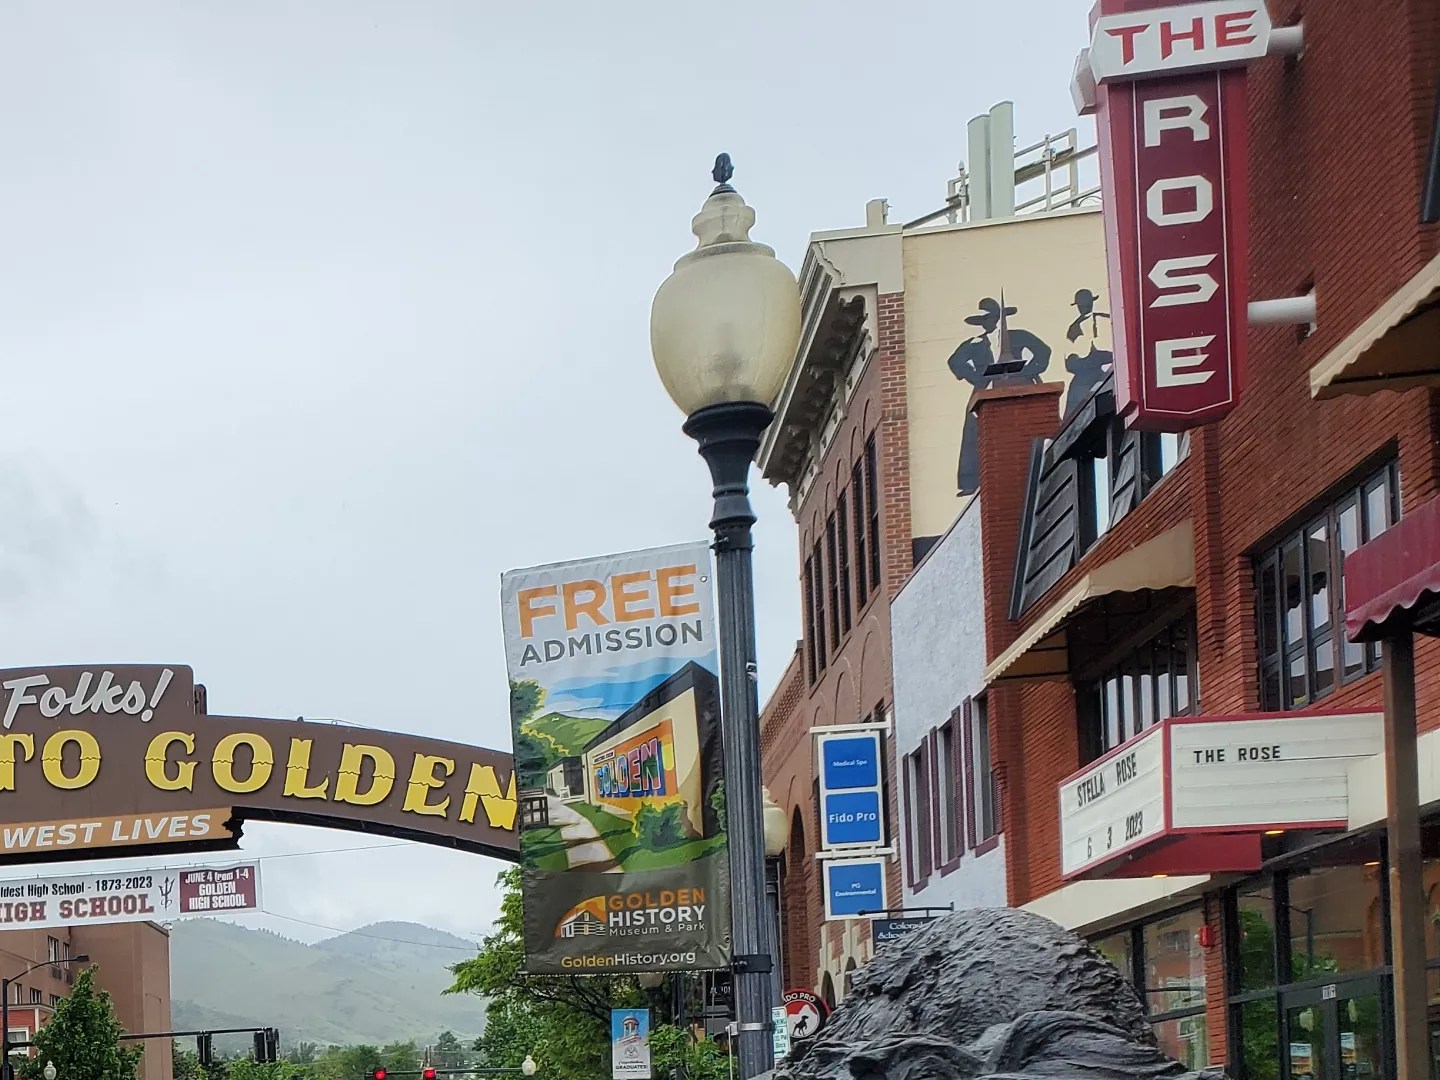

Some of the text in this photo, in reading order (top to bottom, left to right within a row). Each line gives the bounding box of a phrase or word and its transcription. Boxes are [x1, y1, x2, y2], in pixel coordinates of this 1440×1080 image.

[1103, 9, 1259, 65] THE
[1143, 94, 1220, 389] ROSE
[517, 564, 701, 639] FREE
[520, 620, 703, 666] ADMISSION
[2, 669, 174, 731] Folks!
[1193, 745, 1281, 763] THE ROSE
[596, 738, 664, 796] GOLDEN
[145, 731, 518, 830] GOLDEN
[1077, 752, 1138, 806] STELLA ROSE
[829, 812, 876, 823] Fido Pro
[2, 822, 103, 850] WEST
[111, 813, 213, 844] LIVES
[1086, 811, 1144, 859] 6 3 2023
[27, 882, 49, 897] High
[51, 880, 85, 896] School
[95, 876, 153, 892] 1873-2023
[185, 869, 249, 884] JUNE 4 from 1-4
[199, 881, 236, 896] GOLDEN
[608, 888, 705, 910] GOLDEN
[59, 894, 155, 919] SCHOOL
[189, 894, 247, 910] HIGH SCHOOL
[609, 905, 705, 927] HISTORY
[610, 922, 705, 936] Museum & Park
[561, 952, 696, 968] GoldenHistory.org
[800, 992, 816, 1002] PRO
